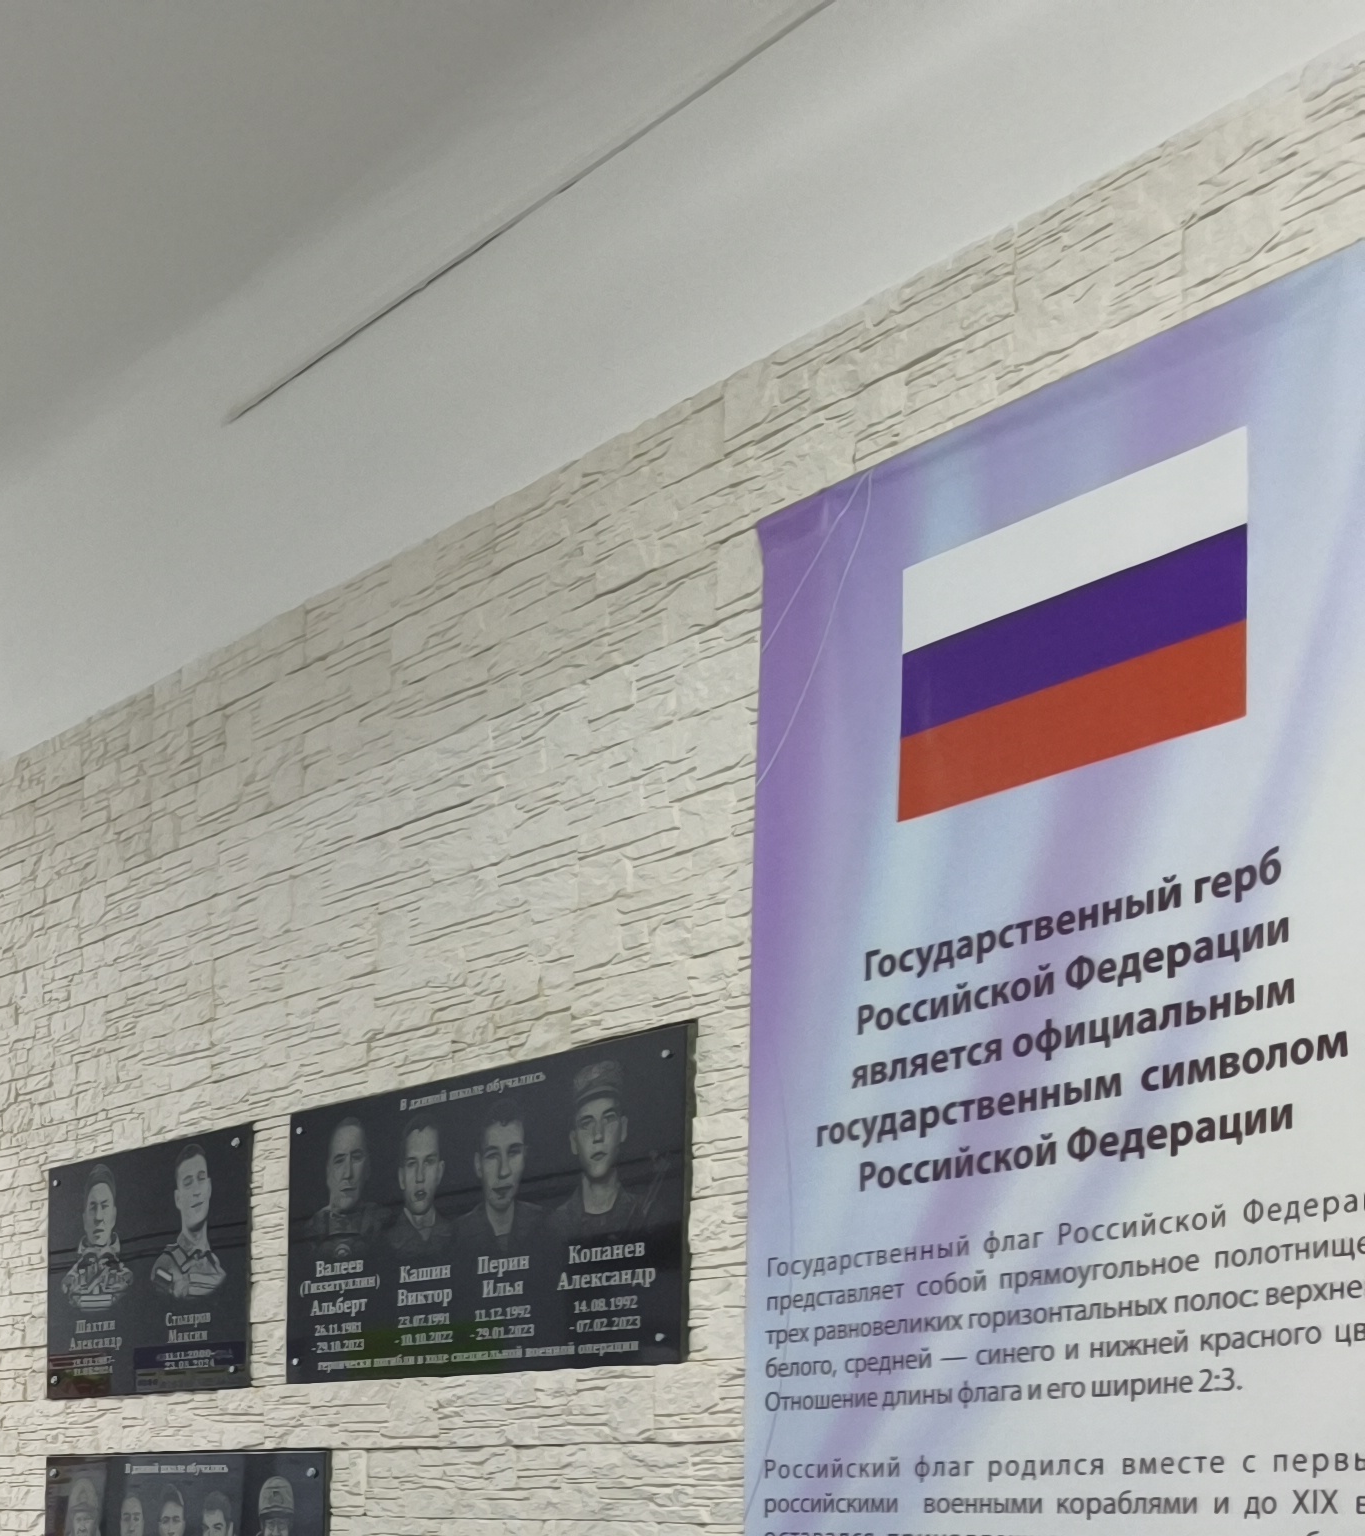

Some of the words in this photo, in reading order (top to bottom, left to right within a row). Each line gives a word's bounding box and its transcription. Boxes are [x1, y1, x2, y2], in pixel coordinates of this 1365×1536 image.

[864, 874, 1182, 981] Государственный
[1194, 846, 1282, 904] герб
[857, 963, 1055, 1035] Российской
[1065, 917, 1289, 990] Федерации
[851, 1038, 1002, 1089] является
[1013, 978, 1295, 1061] официальным
[486, 1071, 546, 1093] обучались
[816, 1073, 1122, 1148] государственным
[1141, 1031, 1348, 1091] символом
[859, 1132, 1057, 1192] Российской
[1067, 1103, 1293, 1162] Федерации
[768, 1235, 969, 1280] Государственный
[983, 1230, 1044, 1259] флаг
[1057, 1203, 1226, 1245] Российской
[1243, 1193, 1365, 1225] Федера
[478, 1255, 529, 1277] Перин
[569, 1242, 645, 1264] Копанев
[316, 1260, 363, 1277] Валеев
[400, 1265, 451, 1283] Кашин
[557, 1267, 656, 1290] Александр
[397, 1289, 452, 1307] Виктор
[482, 1280, 523, 1298] Илья
[767, 1283, 905, 1315] представляет
[917, 1269, 986, 1296] собой
[1000, 1254, 1200, 1294] прямоугольное
[310, 1297, 367, 1316] Альберт
[574, 1295, 638, 1313] 14.08.1992
[765, 1327, 809, 1349] трех
[814, 1314, 963, 1346] равновеликих
[968, 1297, 1168, 1333] горизонтальных
[1174, 1289, 1259, 1313] полос:
[1266, 1280, 1363, 1310] верхне
[765, 1357, 837, 1378] белого,
[845, 1347, 932, 1378] средней
[975, 1345, 1055, 1365] синего
[1065, 1343, 1079, 1360] и
[1090, 1329, 1188, 1358] нижней
[1200, 1326, 1322, 1357] красного
[765, 1392, 878, 1411] Отношение
[881, 1388, 953, 1411] длины
[958, 1380, 1022, 1409] флага
[1028, 1384, 1042, 1400] и
[1047, 1381, 1086, 1399] его
[1091, 1375, 1193, 1402] ширине
[1198, 1367, 1243, 1392] 2:3.
[764, 1456, 900, 1479] Российский
[915, 1455, 975, 1483] флаг
[988, 1458, 1104, 1482] родился
[1122, 1456, 1225, 1475] вместе
[1243, 1455, 1256, 1473] с
[764, 1493, 898, 1518] российскими
[924, 1497, 1043, 1514] военными
[1057, 1490, 1198, 1520] кораблями
[1214, 1497, 1229, 1514] и
[1244, 1496, 1277, 1519] до
[1292, 1489, 1338, 1514] XIX
